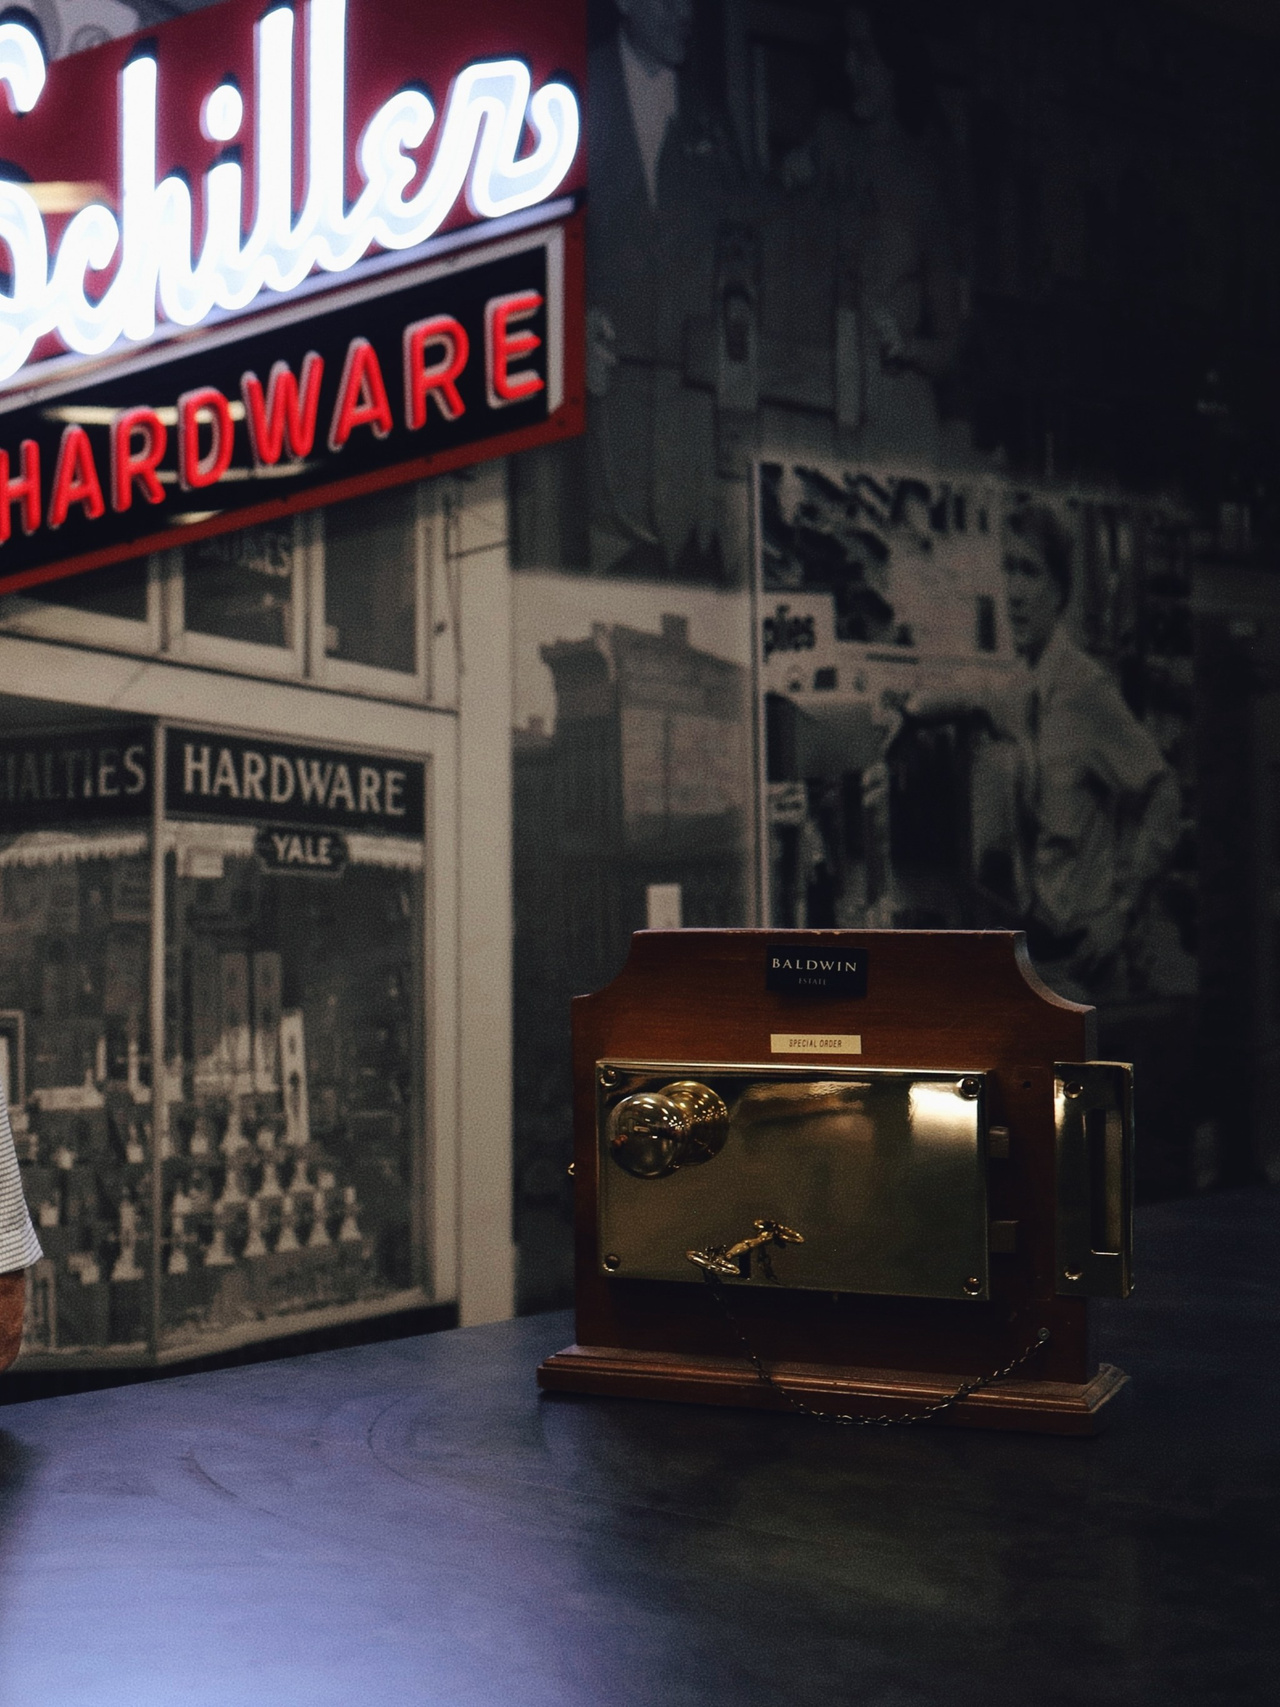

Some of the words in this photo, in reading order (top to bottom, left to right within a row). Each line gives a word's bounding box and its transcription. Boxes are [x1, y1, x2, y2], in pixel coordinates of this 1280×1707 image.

[182, 743, 407, 816] HARDWARE
[271, 833, 334, 866] YALE
[772, 957, 857, 972] BALDWIN
[788, 1038, 818, 1048] SPECIAL
[819, 1039, 842, 1049] ORDER
